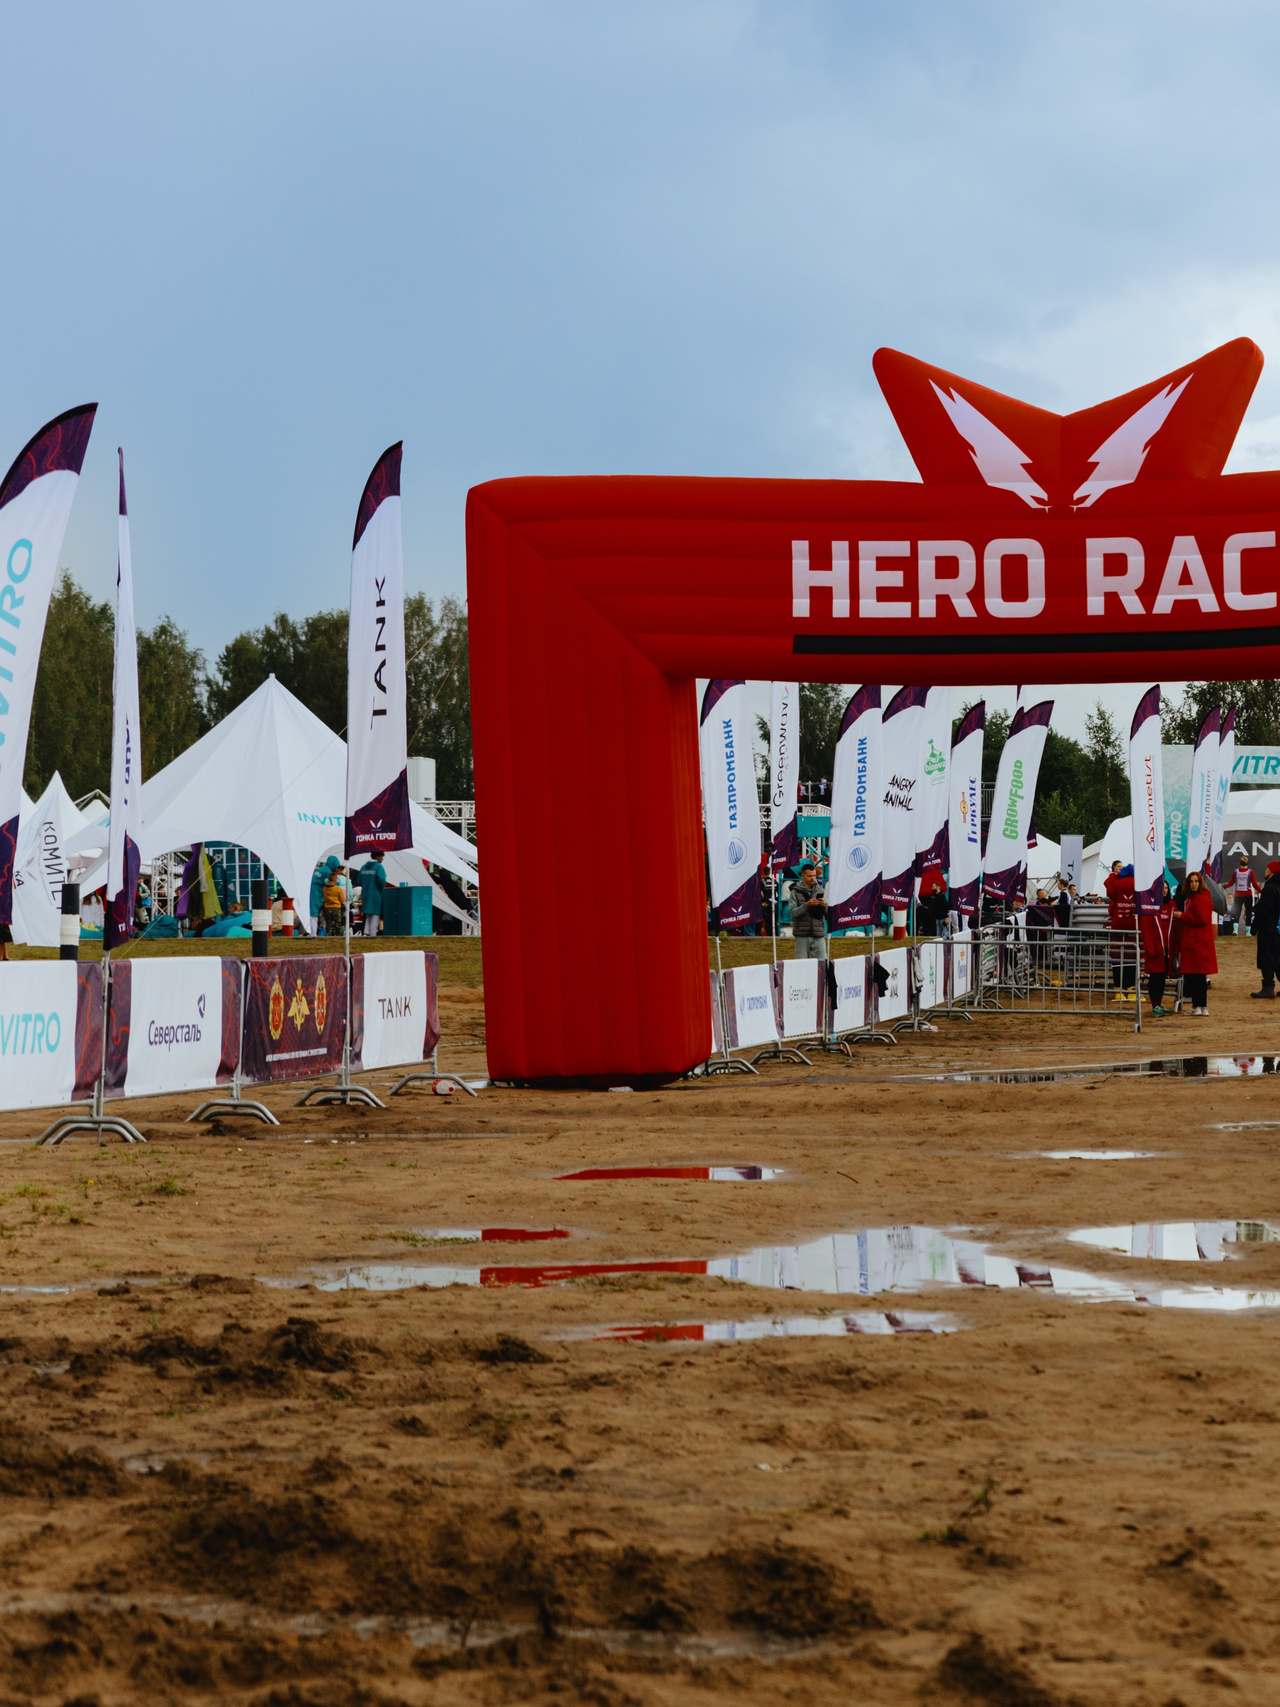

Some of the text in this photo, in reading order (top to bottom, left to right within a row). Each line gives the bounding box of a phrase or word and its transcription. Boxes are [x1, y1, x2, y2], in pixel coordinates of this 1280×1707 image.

[791, 537, 1046, 619] HERO
[370, 575, 387, 731] TANK
[722, 718, 738, 829] ГАЗПРОМБАНК
[853, 736, 868, 837] ГАЗПРОМБАНК
[888, 773, 916, 793] ANGRY
[297, 812, 343, 827] INVIT
[1002, 759, 1024, 840] GROWFOOD
[355, 833, 375, 843] ГОНКА
[377, 995, 413, 1020] TANK
[0, 1011, 61, 1056] VITRO
[148, 1019, 202, 1052] Северсталь
